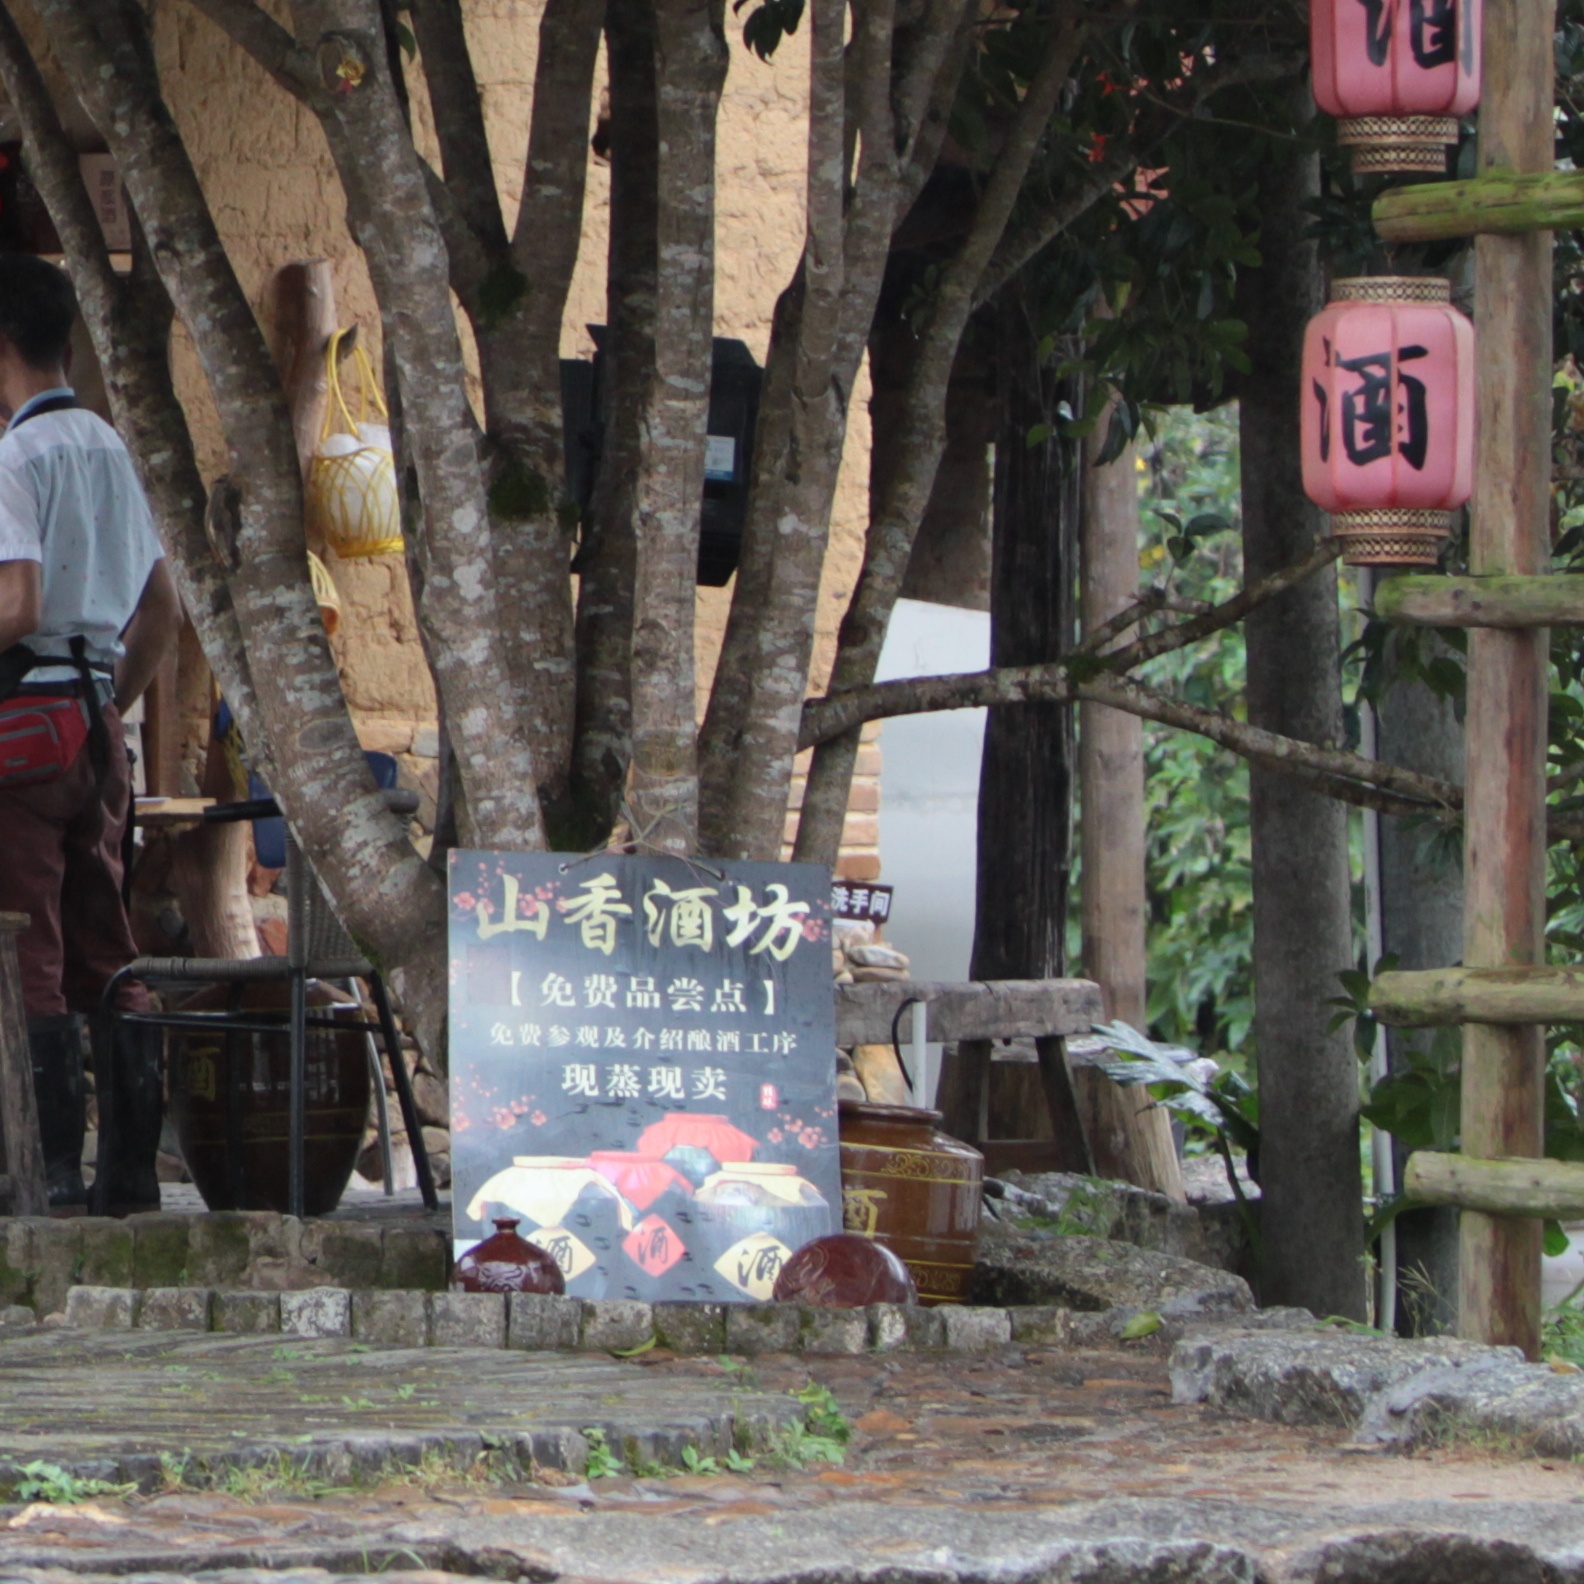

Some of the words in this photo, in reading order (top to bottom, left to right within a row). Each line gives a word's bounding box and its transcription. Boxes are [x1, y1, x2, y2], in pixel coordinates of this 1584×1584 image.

[1313, 340, 1429, 470] 酒
[477, 872, 810, 961] 山香酒坊
[832, 886, 891, 916] 洗手间
[490, 1023, 797, 1055] 免费参观及介绍酿酒工序
[562, 1064, 727, 1101] 现蒸现卖
[637, 1226, 668, 1265] 酒
[737, 1245, 783, 1288] 酒
